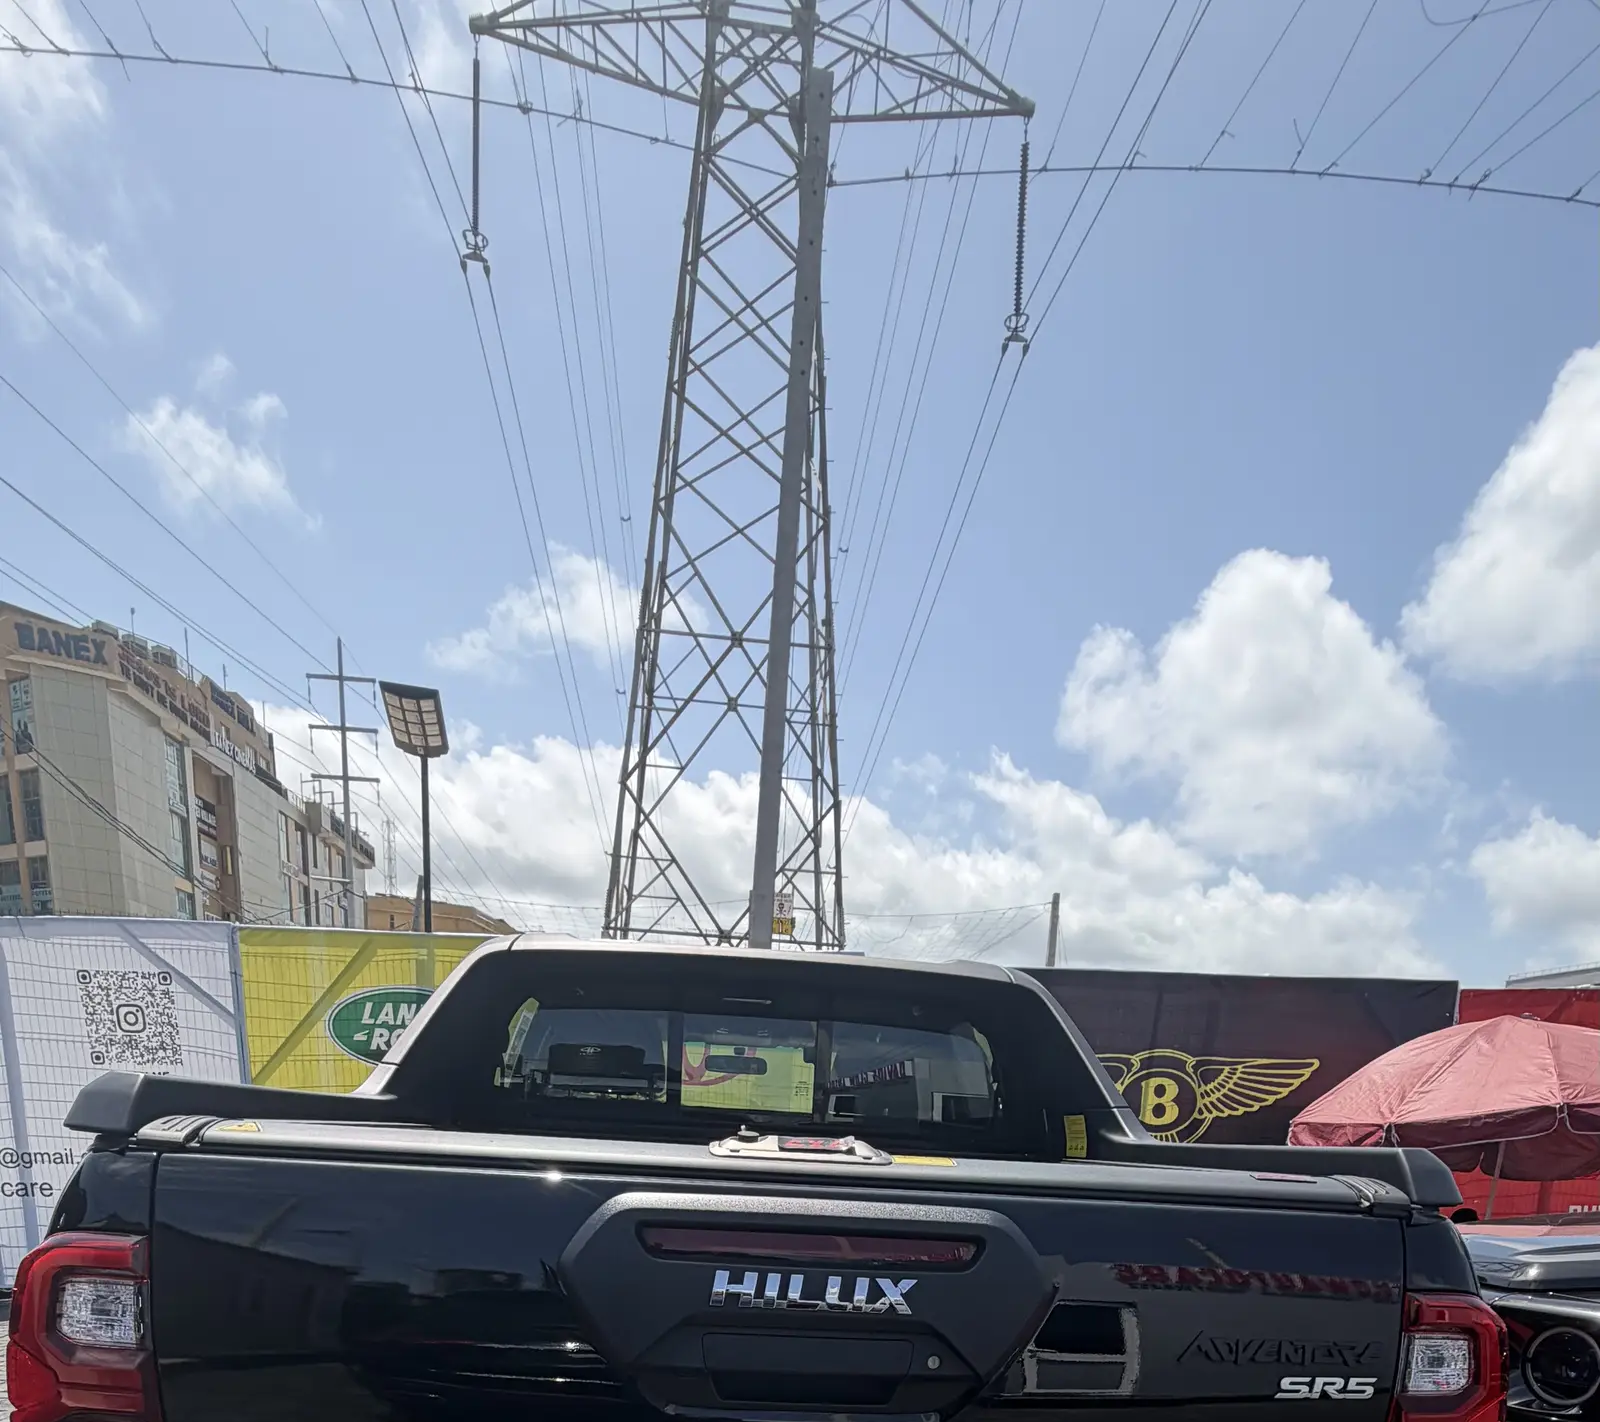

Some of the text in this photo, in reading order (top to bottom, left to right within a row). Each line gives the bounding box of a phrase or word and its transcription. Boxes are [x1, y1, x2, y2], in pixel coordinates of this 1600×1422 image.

[14, 621, 108, 666] BANEX
[361, 1001, 424, 1026] LAN
[1138, 1076, 1180, 1126] B
[709, 1269, 919, 1315] HILUX
[1274, 1376, 1378, 1400] SR5
